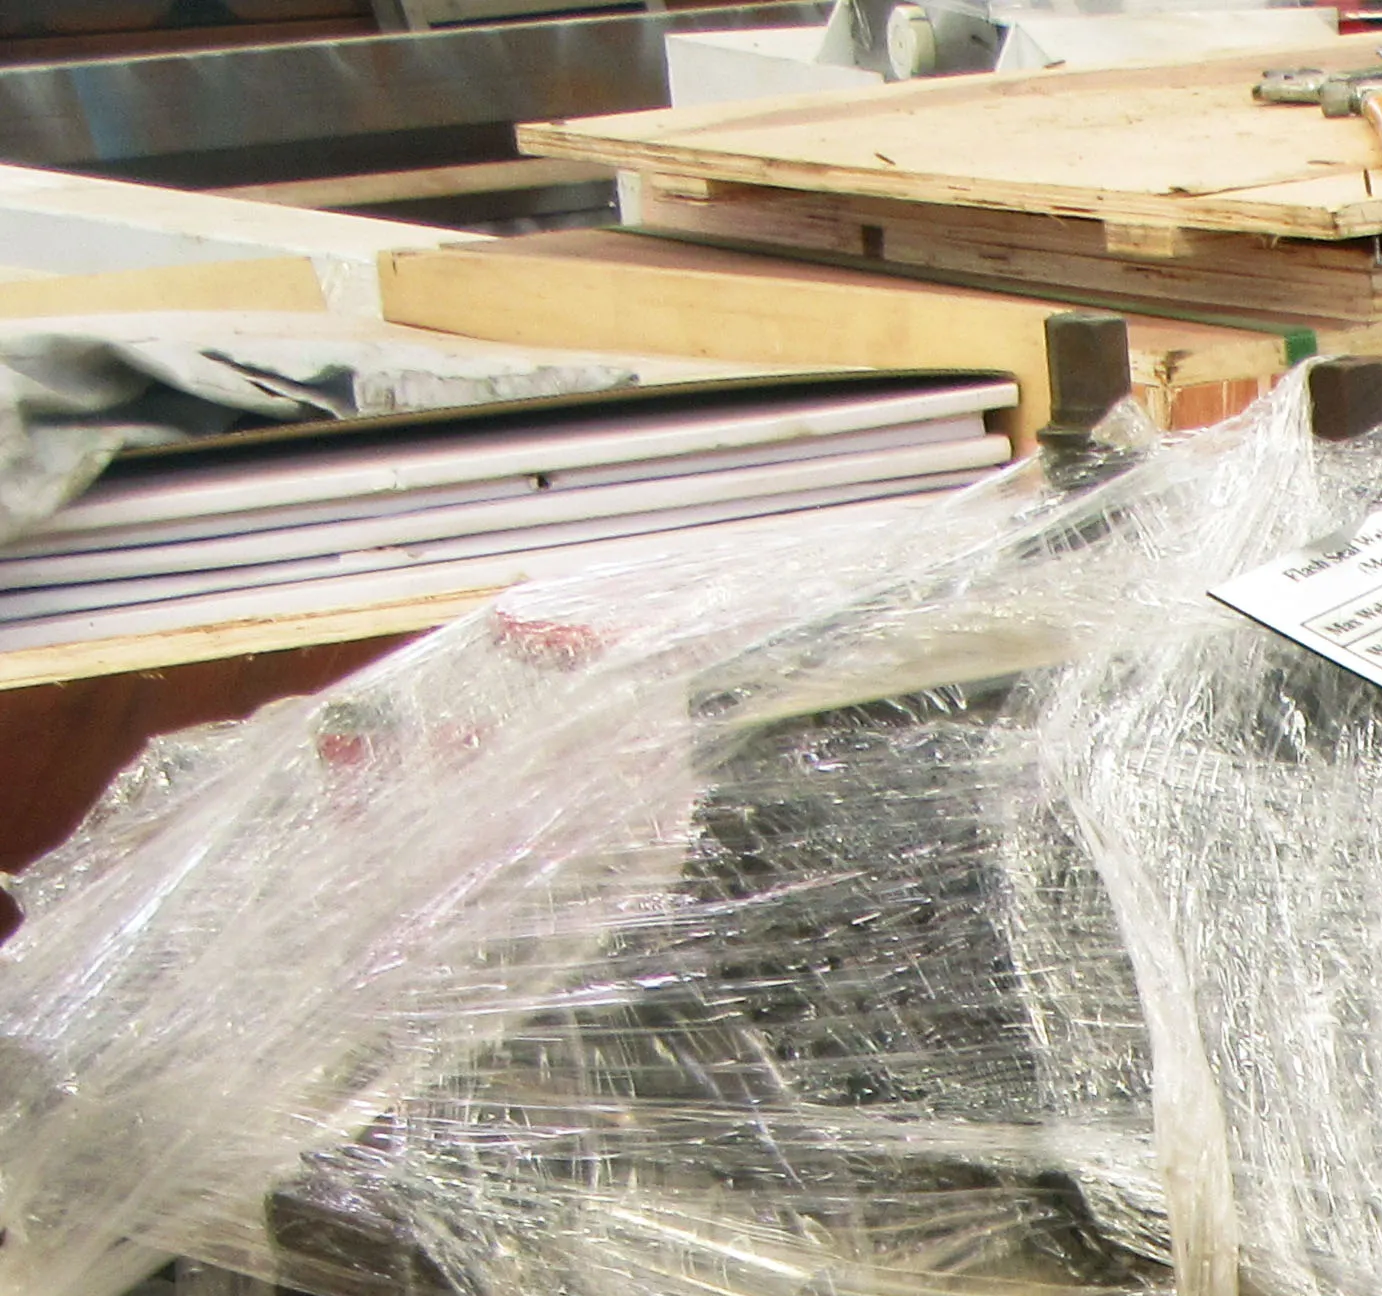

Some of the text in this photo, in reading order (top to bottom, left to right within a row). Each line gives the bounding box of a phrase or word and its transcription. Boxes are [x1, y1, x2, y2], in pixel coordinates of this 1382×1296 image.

[1282, 558, 1331, 582] Flash
[1322, 541, 1360, 563] Seal
[1324, 618, 1364, 637] Max
